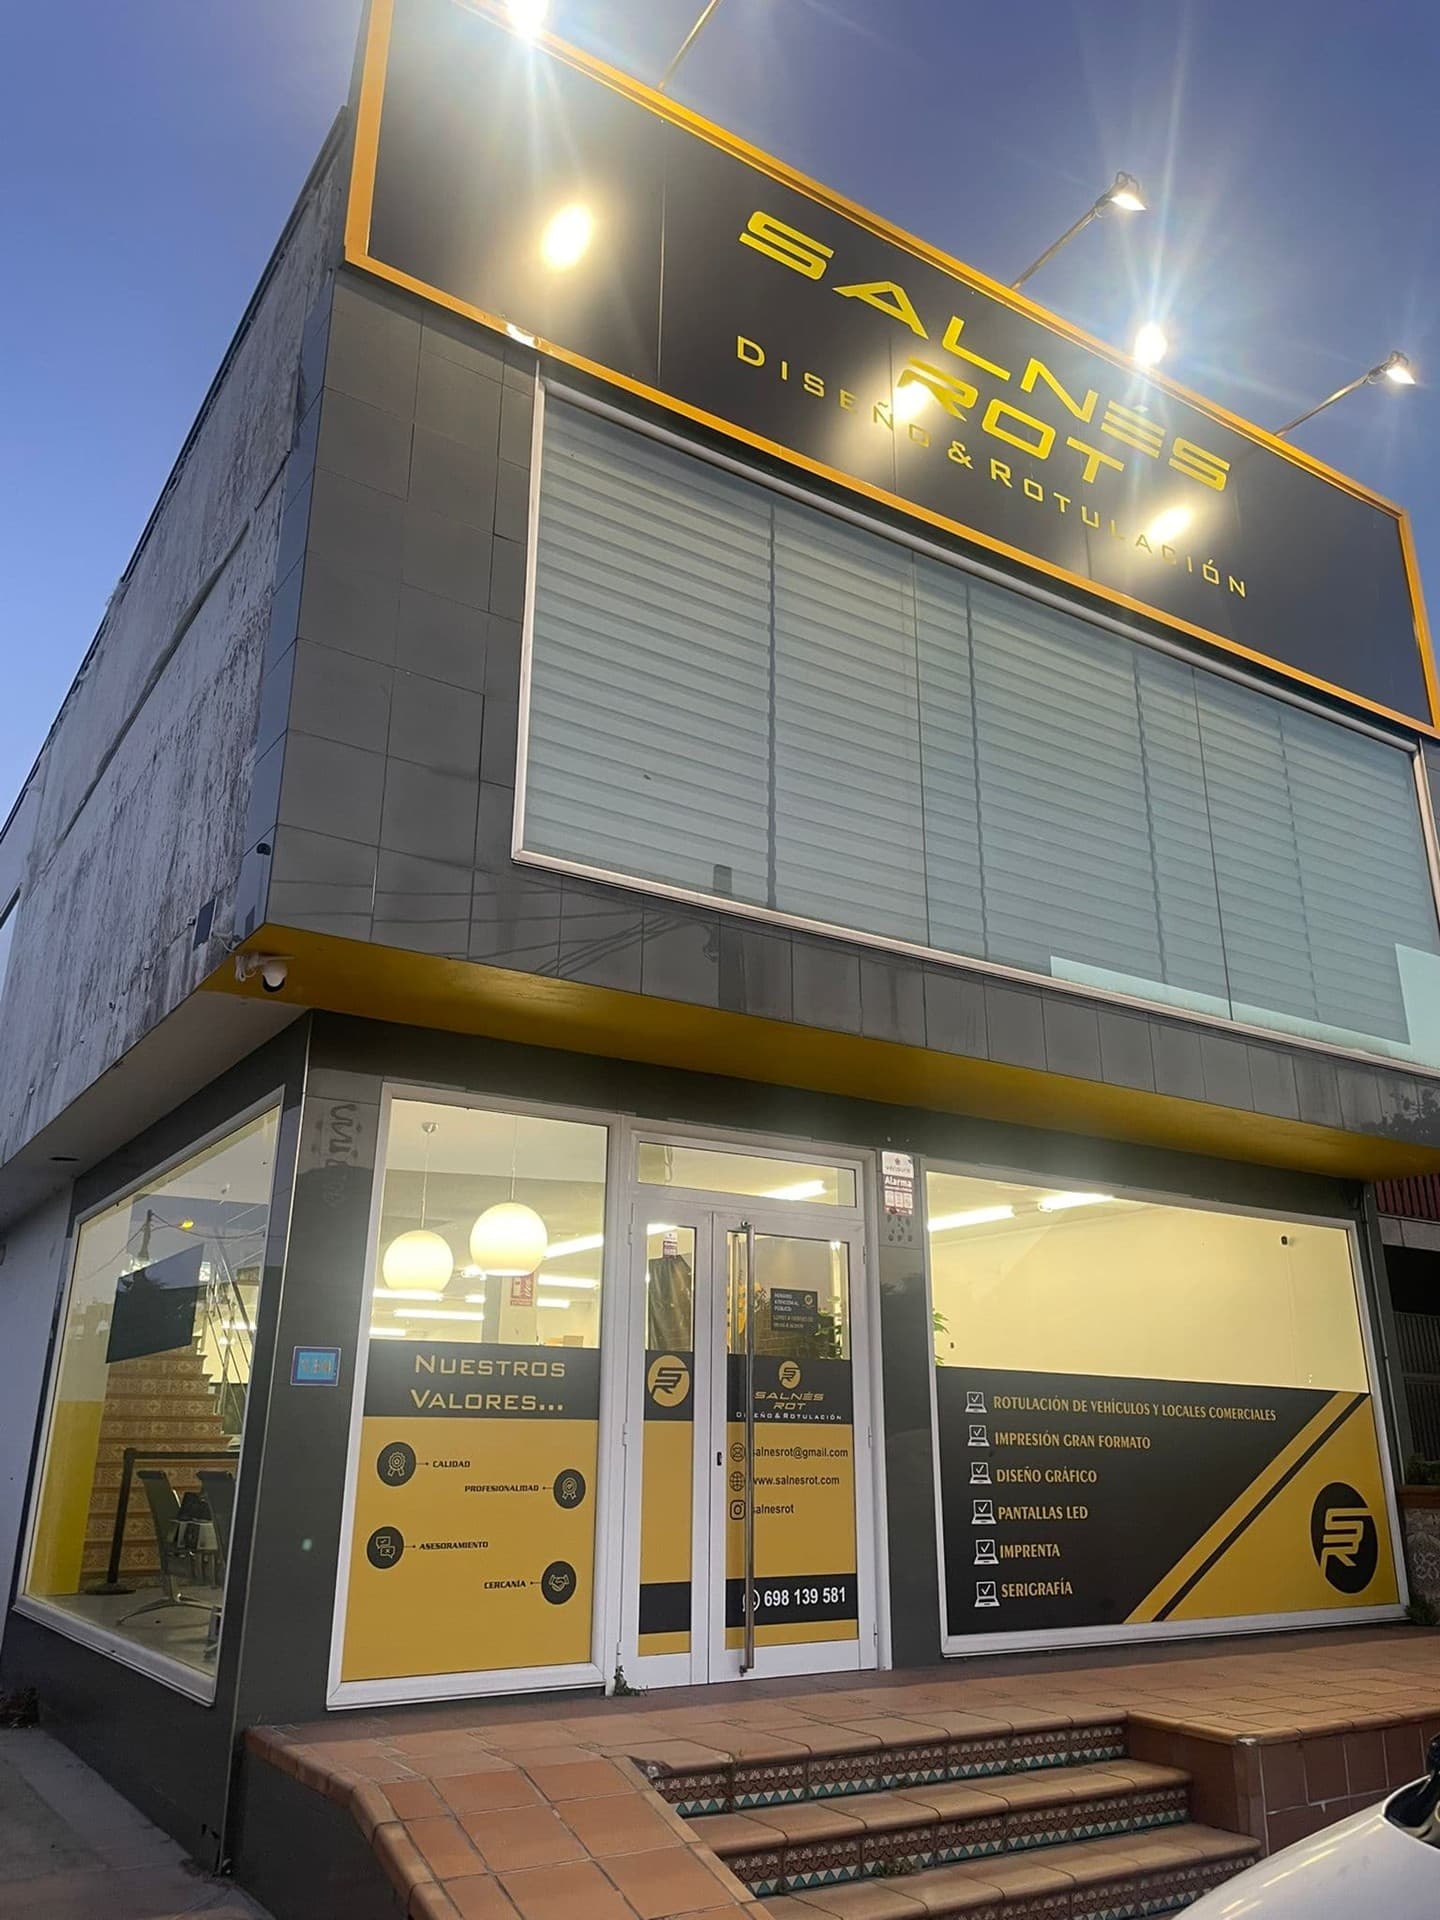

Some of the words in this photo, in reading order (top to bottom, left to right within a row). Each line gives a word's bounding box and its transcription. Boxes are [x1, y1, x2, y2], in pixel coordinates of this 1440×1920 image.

[898, 357, 1125, 484] ROT
[885, 1175, 912, 1188] Alarma
[415, 1355, 565, 1377] NUESTROS
[411, 1389, 563, 1411] VALORES...
[754, 1391, 824, 1401] SALNÉS
[773, 1401, 806, 1410] ROT
[993, 1394, 1069, 1412] ROTULACIÓN
[1073, 1400, 1089, 1413] DE
[1091, 1398, 1151, 1416] VEHÍCULOS
[1152, 1403, 1159, 1416] Y
[1162, 1403, 1206, 1418] LOCALES
[1208, 1405, 1276, 1421] COMERCIALES
[995, 1430, 1060, 1447] IMPRESIÓN
[1063, 1434, 1095, 1448] GRAN
[1098, 1435, 1151, 1449] FORMATO
[432, 1460, 471, 1469] CALIDAD
[996, 1466, 1042, 1484] DISEÑO
[1045, 1466, 1097, 1484] GRÁFICO
[464, 1484, 539, 1493] PROFESIONALIDAD
[998, 1505, 1064, 1521] PANTALLAS
[1067, 1505, 1088, 1520] LED
[419, 1541, 489, 1550] ASESORAMIENTO
[1000, 1543, 1060, 1559] IMPRENTA
[483, 1579, 526, 1590] CERCANÍA
[1001, 1578, 1073, 1598] SERIGRAFÍA
[764, 1589, 789, 1606] 698
[794, 1588, 817, 1605] 139
[822, 1586, 846, 1604] 581
